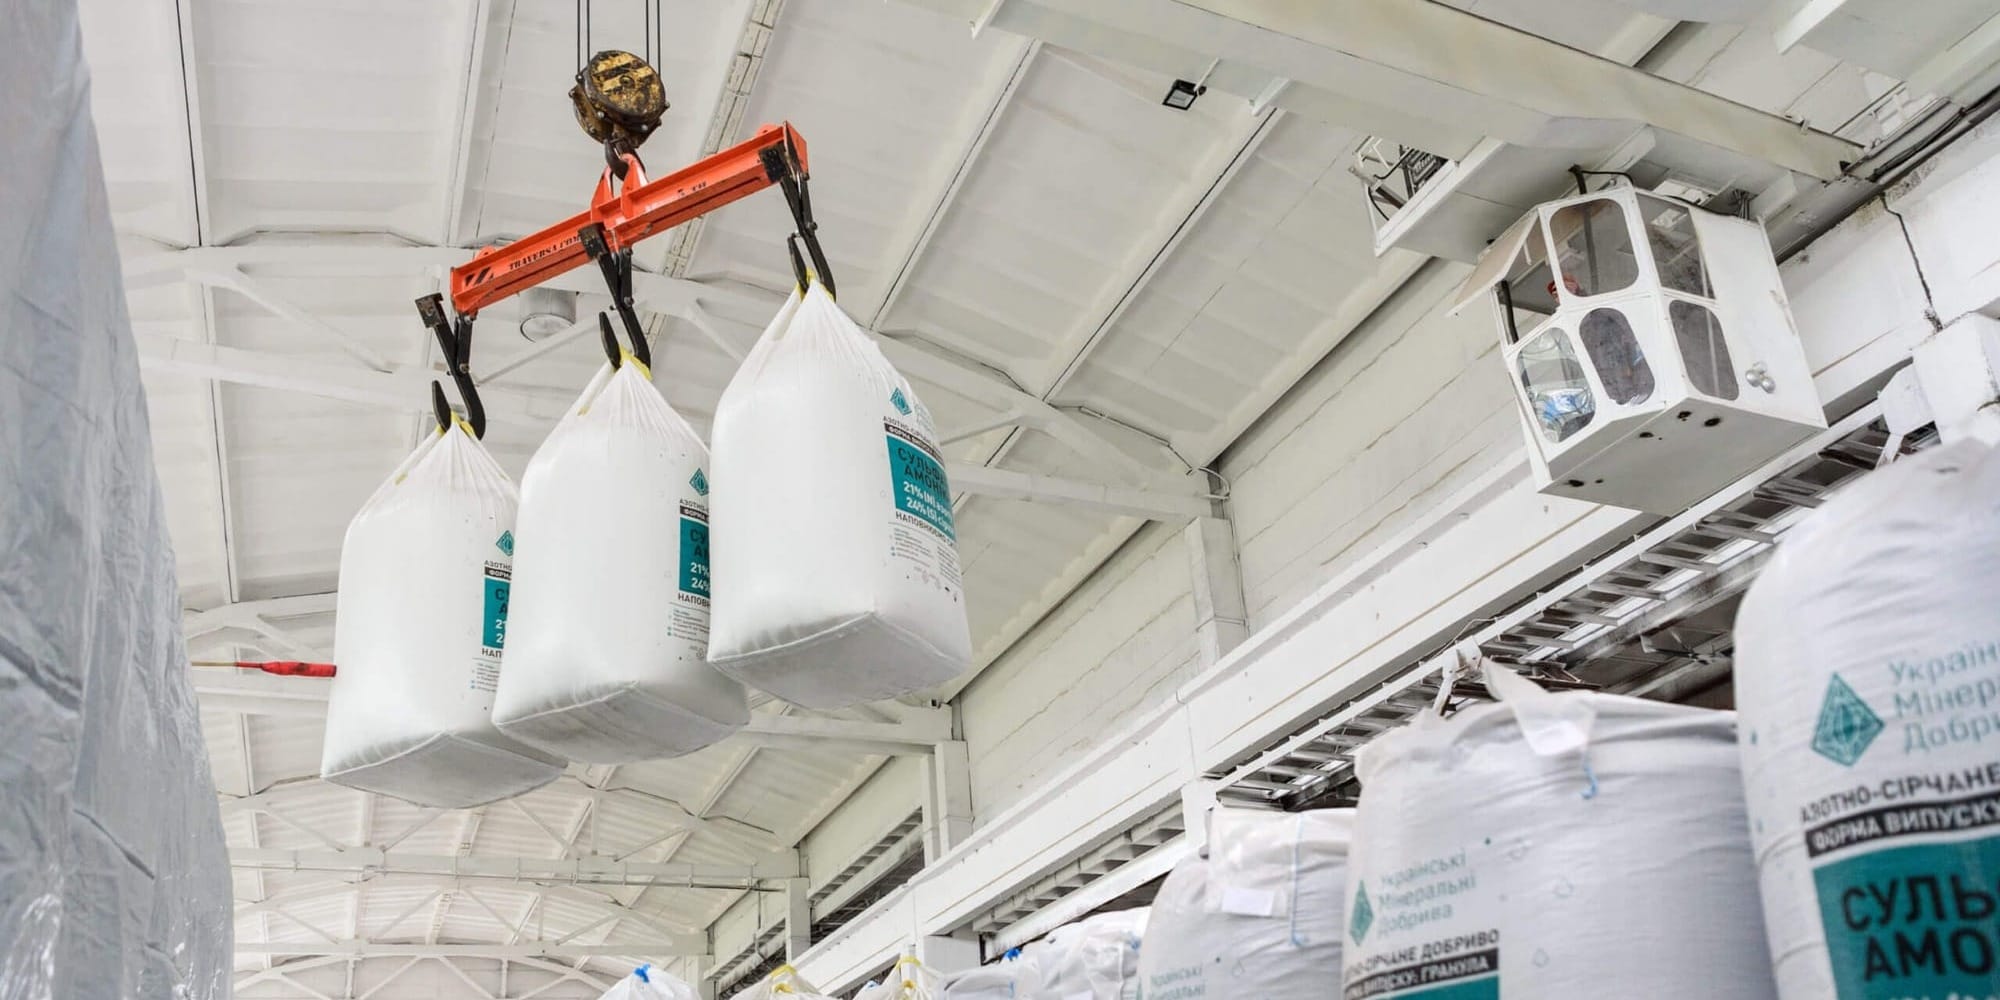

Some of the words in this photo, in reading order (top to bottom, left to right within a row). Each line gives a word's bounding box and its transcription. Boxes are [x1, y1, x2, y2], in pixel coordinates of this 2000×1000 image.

[903, 480, 924, 500] 21%
[906, 496, 927, 516] 24%
[1893, 675, 2000, 720] Мінер
[1812, 817, 1882, 851] ФОРМА
[1840, 872, 2000, 932] СУЛЬ
[1421, 928, 1499, 961] ДОБРИВО
[1863, 926, 2000, 982] АМО
